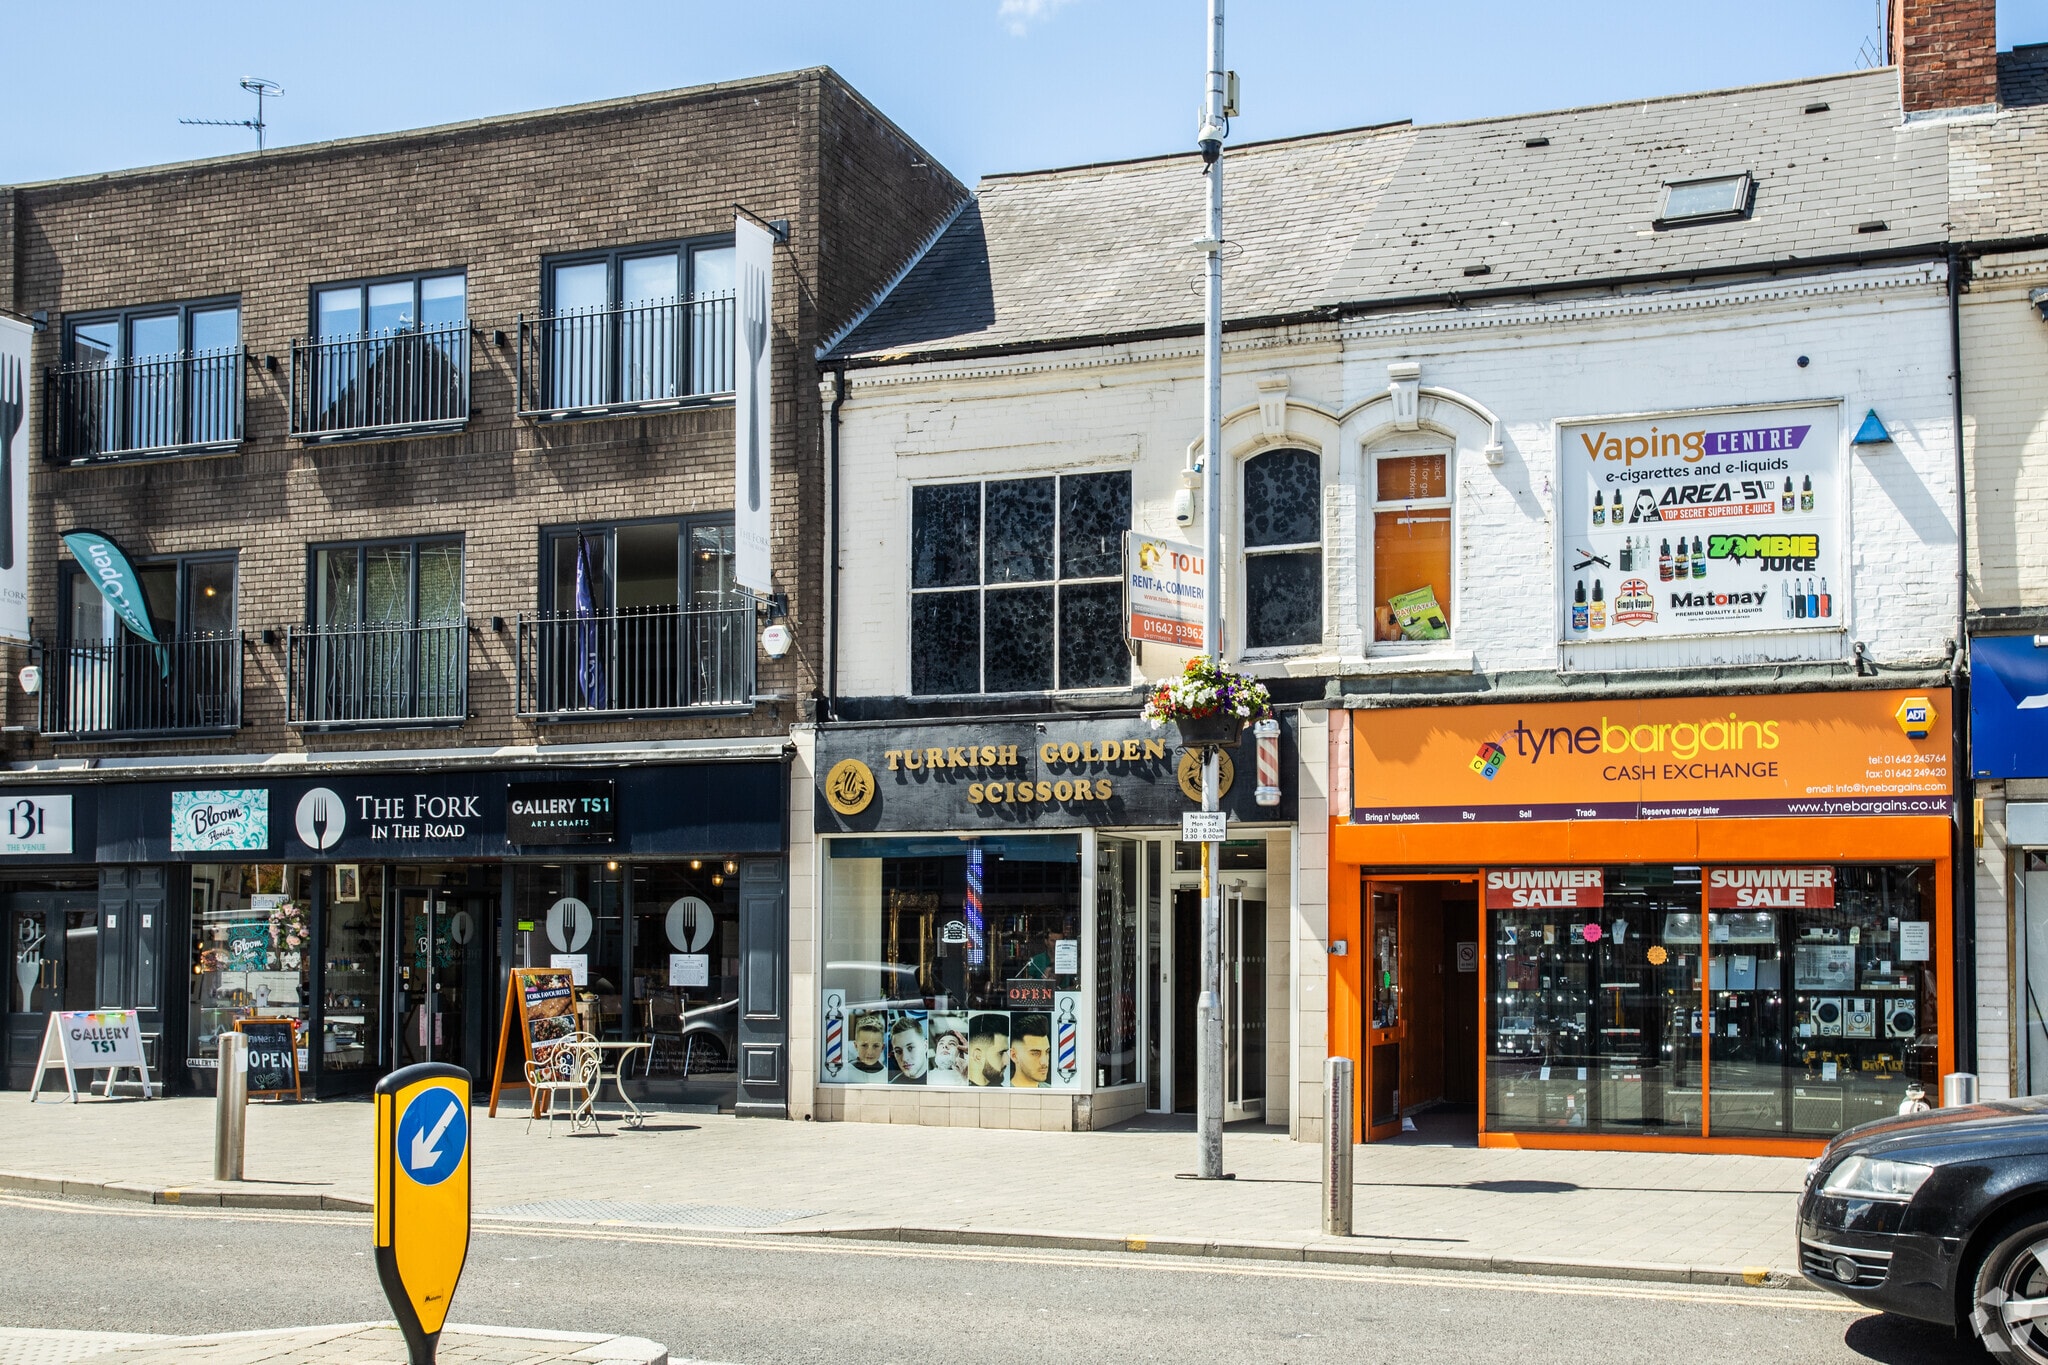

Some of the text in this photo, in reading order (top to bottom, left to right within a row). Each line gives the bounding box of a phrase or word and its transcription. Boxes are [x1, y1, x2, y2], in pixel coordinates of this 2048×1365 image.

[1581, 426, 1793, 466] Vaping CENTRE
[1605, 458, 1788, 484] e-cigarettes and e-liquids
[1665, 503, 1773, 520] TOP SECRET SUPERIOR E-JUICE
[1709, 534, 1818, 558] ZOMBIE
[1170, 552, 1190, 572] TO
[1760, 558, 1816, 572] JUICE
[4, 588, 27, 600] FORK
[1396, 607, 1410, 618] PAY
[1617, 599, 1652, 611] Simply Vapour
[1144, 619, 1173, 635] 01642
[1907, 710, 1926, 720] ADT
[884, 738, 1166, 771] TURKISH GOLDEN
[1868, 754, 1947, 764] tel: 01642 245764
[1603, 761, 1778, 781] CASH EXCHANGE
[1865, 768, 1947, 779] fax: 01642 249420
[967, 779, 1113, 804] SCISSORS
[1806, 782, 1947, 794] email: info@tynebargains.com
[511, 797, 609, 815] GALLERY TS1
[1576, 809, 1597, 817] Trade
[1642, 806, 1720, 817] Reserve now pay later
[1788, 798, 1947, 813] www.tynebargains.co.uk
[8, 800, 46, 839] 131
[191, 805, 242, 835] Bloom
[1365, 813, 1383, 822] Bring
[1391, 812, 1420, 822] buyback
[1462, 811, 1476, 821] Buy
[1519, 810, 1532, 818] Sell
[557, 819, 589, 827] CRAFTS
[207, 827, 235, 844] Florists
[1487, 870, 1602, 889] SUMMER
[1710, 869, 1833, 888] SUMMER
[1512, 889, 1577, 907] SALE
[1736, 888, 1806, 907] SALE
[18, 917, 41, 943] 131
[1530, 930, 1542, 938] S10
[232, 938, 263, 956] Bloom
[527, 988, 571, 1000] FORK FAVOURITES
[1009, 988, 1052, 1000] OPEN
[71, 1026, 129, 1041] GALLERY
[91, 1040, 116, 1053] TS1
[188, 1059, 212, 1067] GALLERY
[1331, 1076, 1340, 1119] CENTRAL
[1331, 1122, 1340, 1152] ROAD
